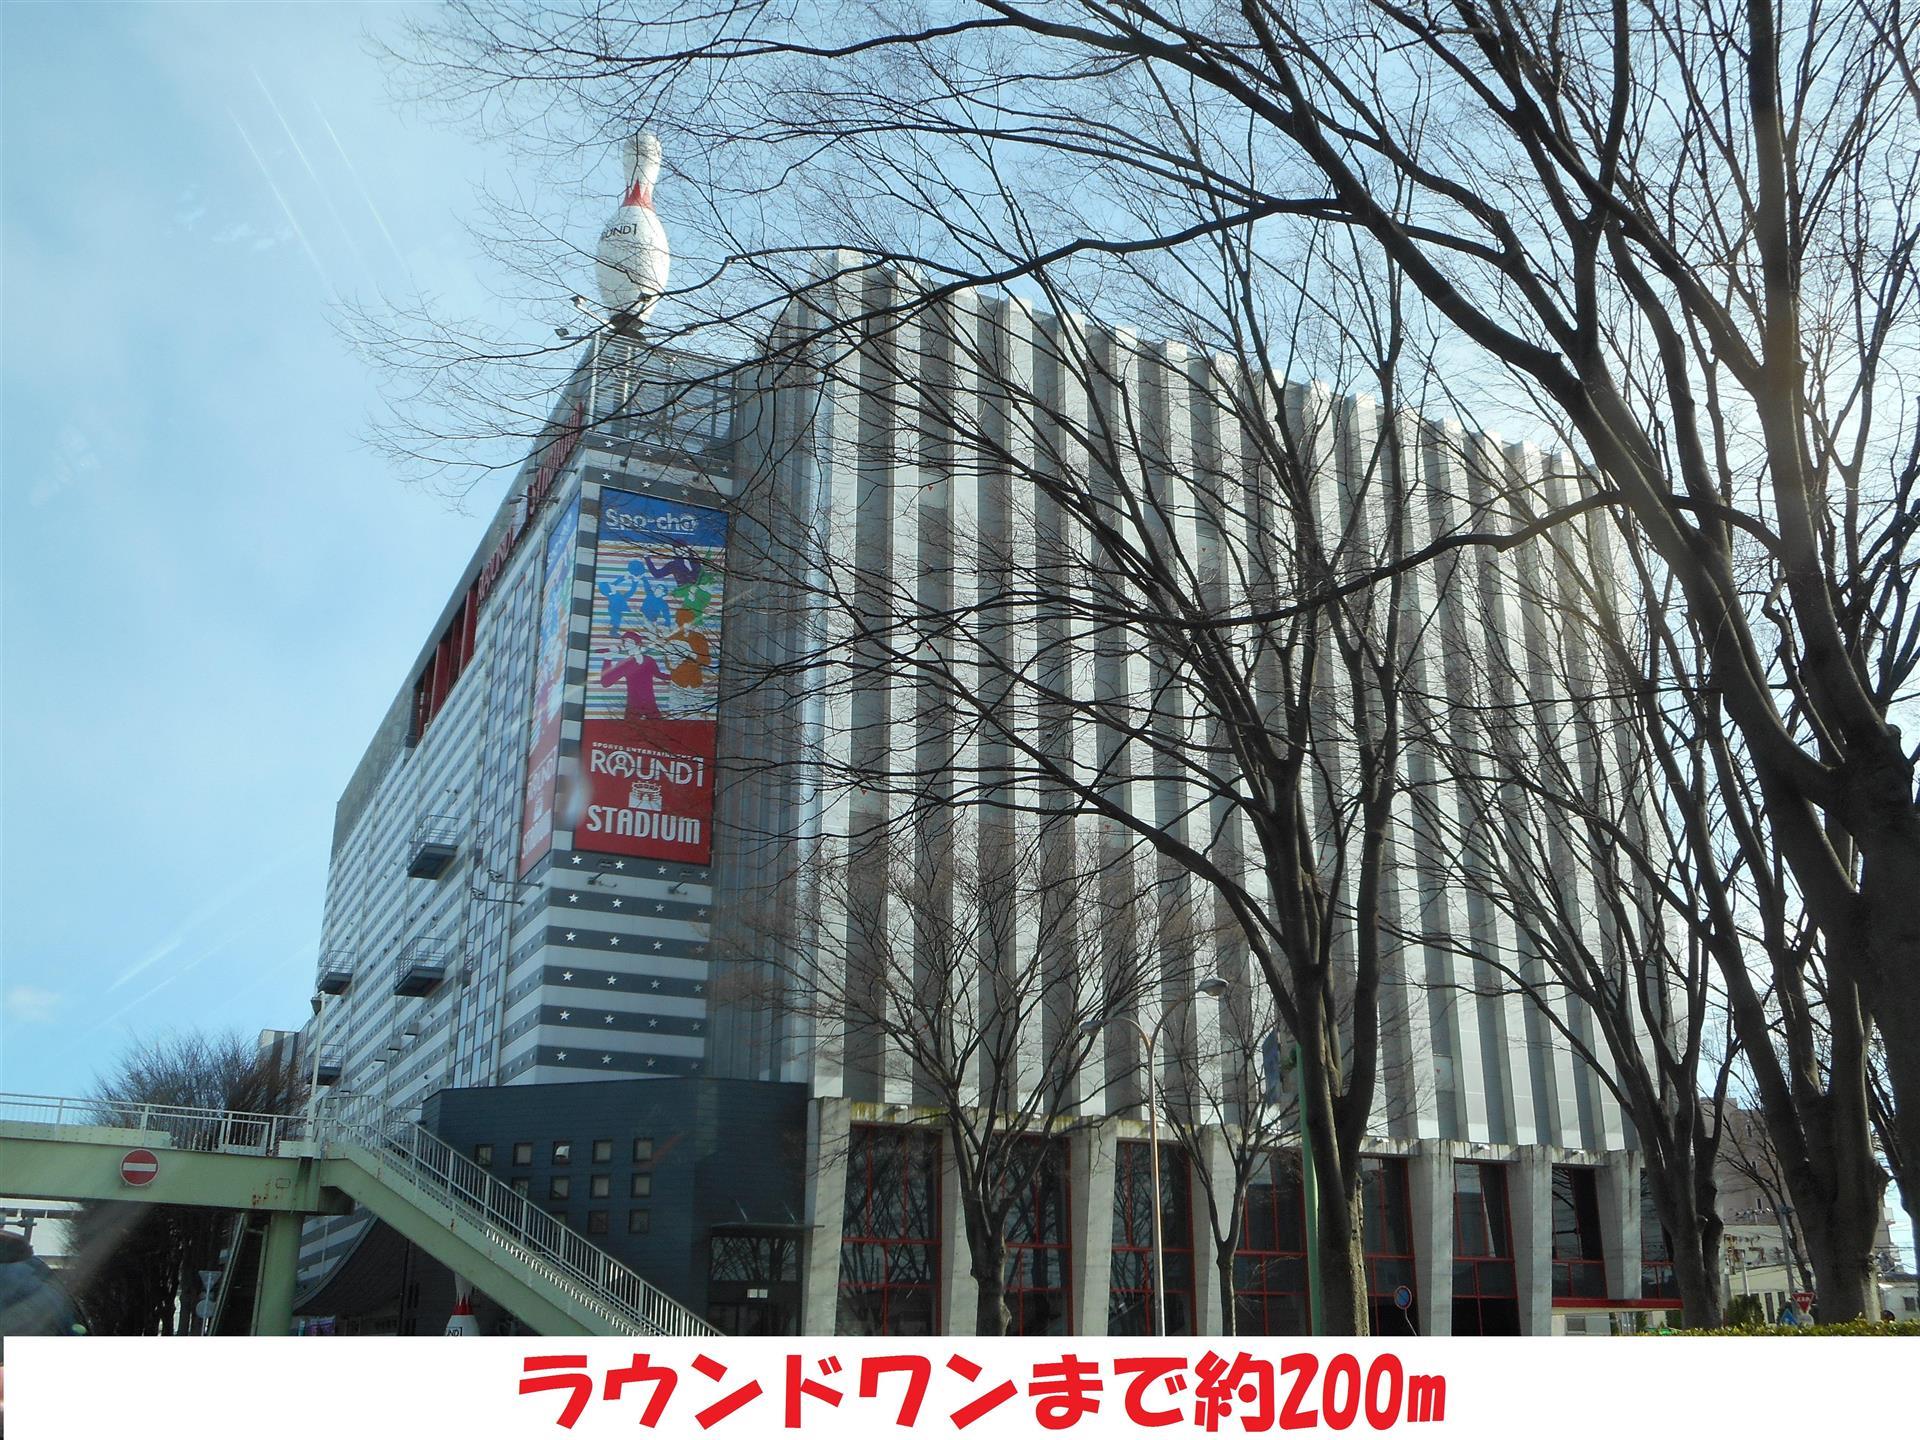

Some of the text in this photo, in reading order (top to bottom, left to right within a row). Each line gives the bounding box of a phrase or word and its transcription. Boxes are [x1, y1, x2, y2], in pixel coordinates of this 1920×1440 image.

[592, 741, 624, 751] SPORTS
[590, 749, 704, 787] ROUND1
[586, 804, 701, 845] STADIUM
